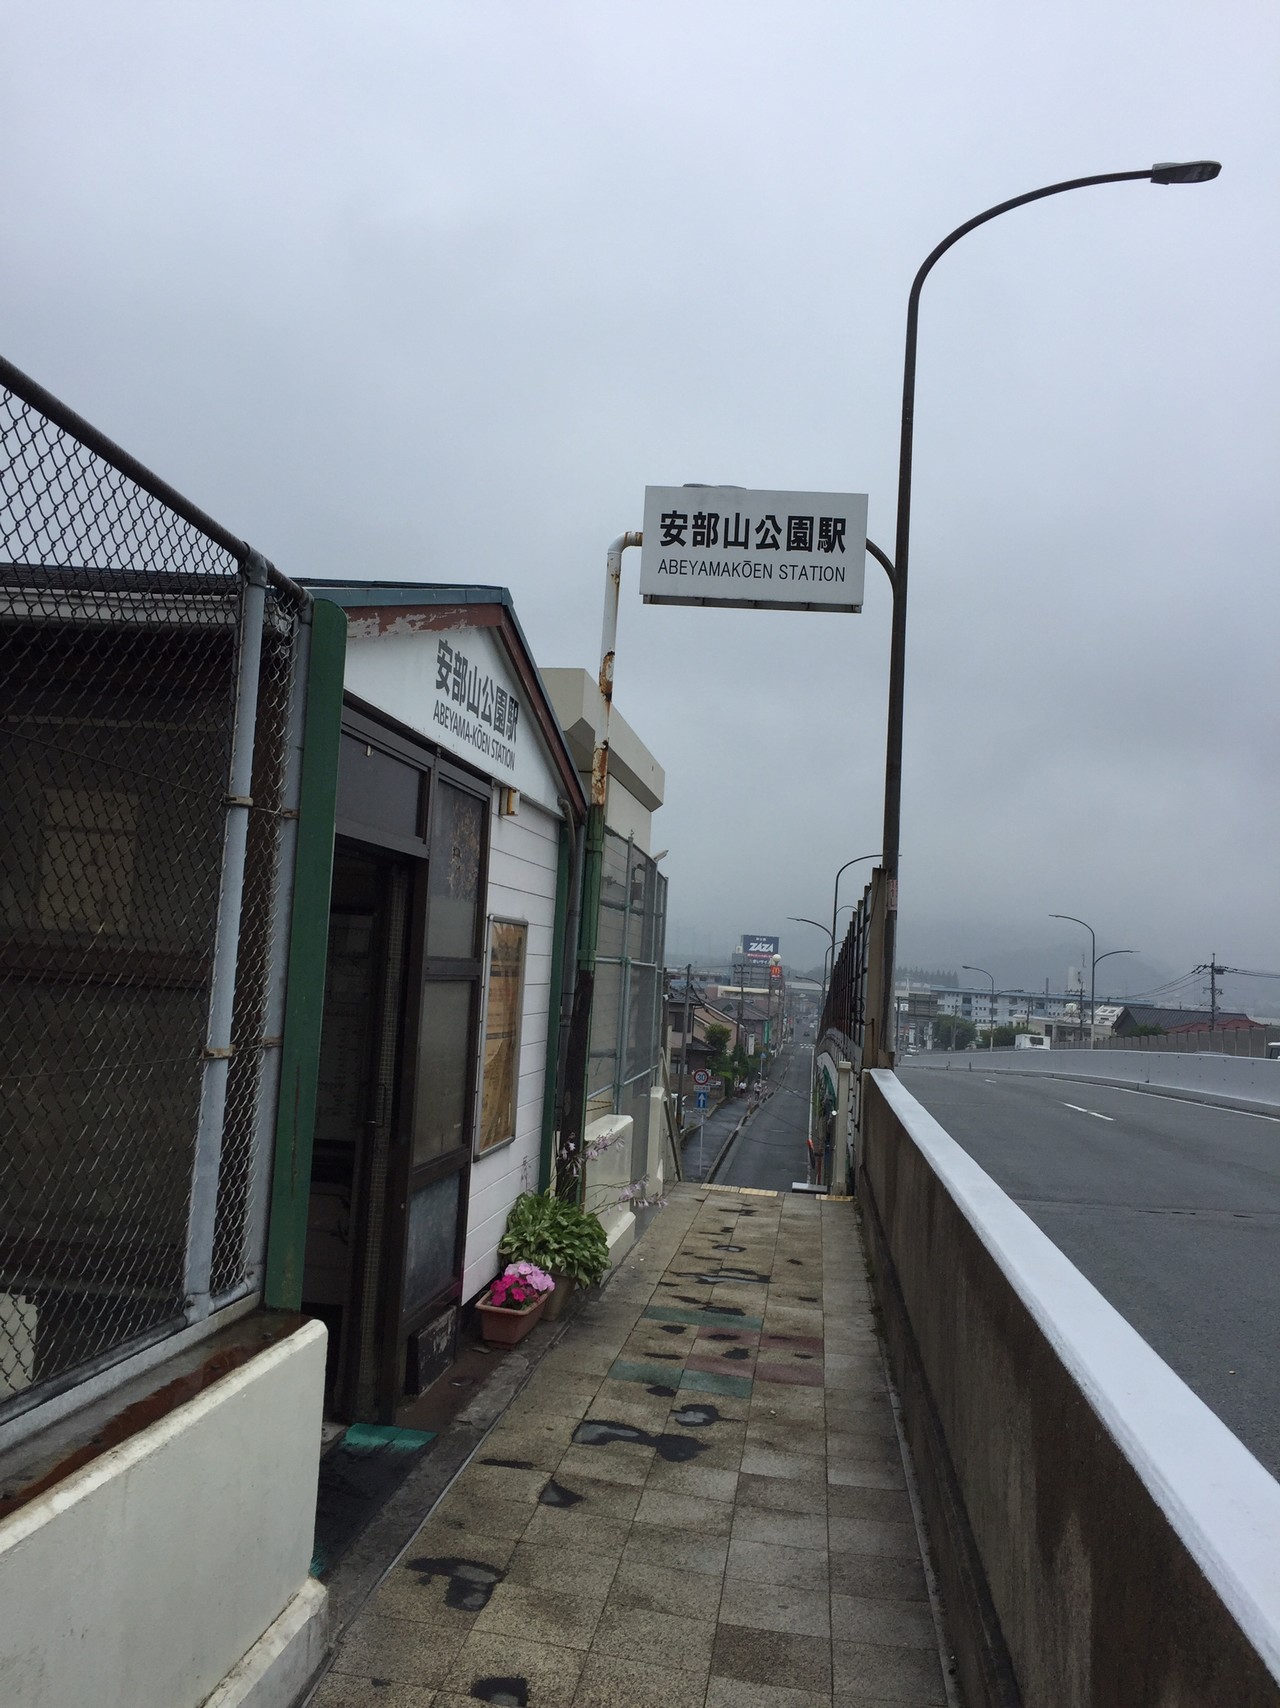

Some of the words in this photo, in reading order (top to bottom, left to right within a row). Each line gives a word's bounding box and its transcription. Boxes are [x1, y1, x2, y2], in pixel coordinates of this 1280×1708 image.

[659, 510, 846, 553] 安部山公園駅
[657, 559, 773, 579] ABEYAMAKŌEN
[778, 564, 846, 582] STATION
[435, 638, 520, 744] 安部山公園駅
[433, 699, 491, 756] ABEYAMA-KŌEN
[491, 738, 516, 771] STATION
[748, 942, 774, 952] ZAZA
[696, 1073, 706, 1081] 30
